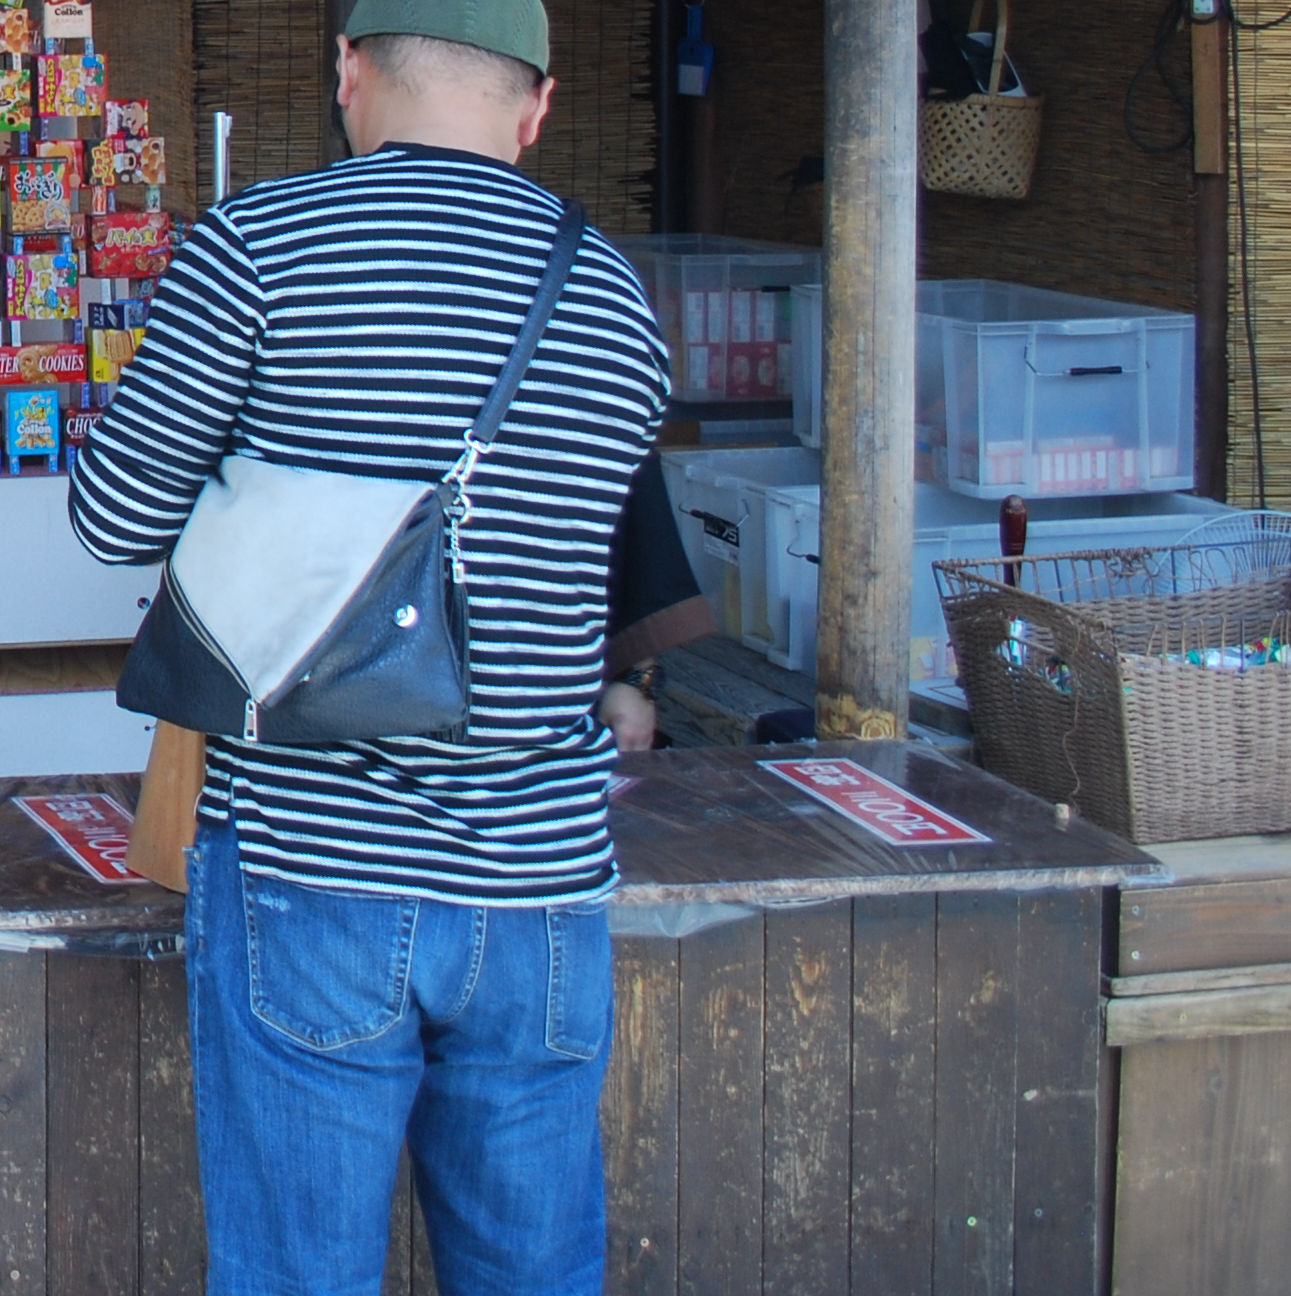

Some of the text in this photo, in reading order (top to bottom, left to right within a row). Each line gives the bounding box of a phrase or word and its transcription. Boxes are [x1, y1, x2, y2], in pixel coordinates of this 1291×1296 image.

[54, 7, 83, 16] Collon
[16, 171, 63, 201] おにぎり
[106, 228, 157, 247] パイの実
[39, 355, 84, 372] COOKIES
[17, 424, 52, 435] Collon
